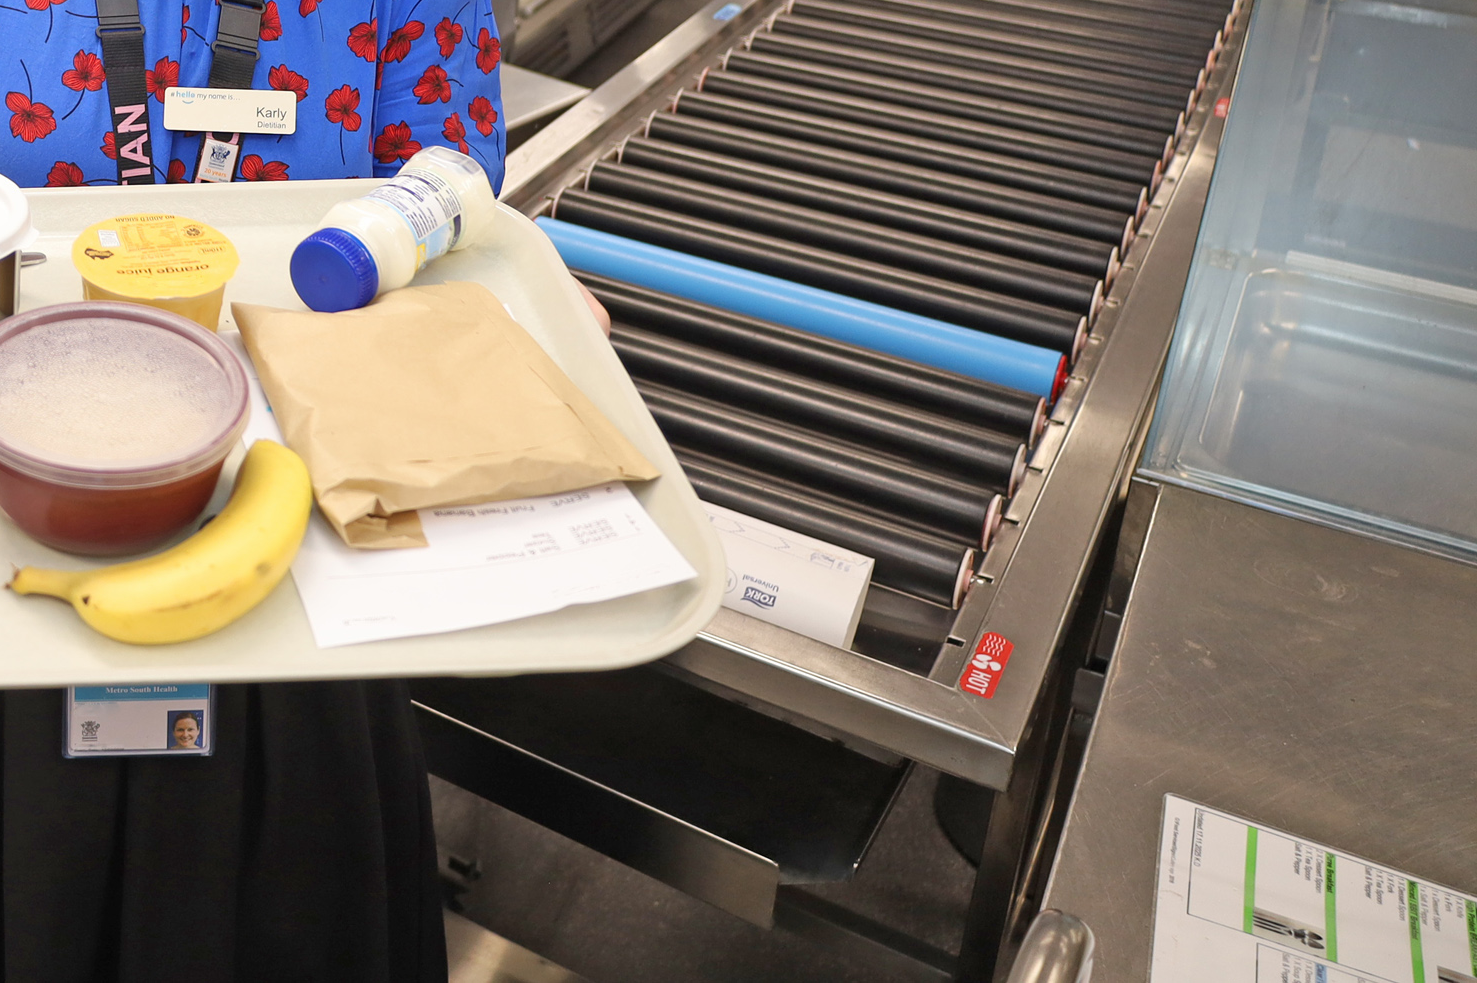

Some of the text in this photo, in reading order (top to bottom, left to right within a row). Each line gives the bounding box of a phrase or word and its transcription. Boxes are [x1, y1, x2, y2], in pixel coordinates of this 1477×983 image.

[256, 107, 287, 121] Karly
[257, 121, 286, 129] Dietitian
[114, 103, 151, 185] IAN
[117, 263, 209, 278] orange juice
[550, 492, 590, 507] SERVE
[433, 509, 476, 517] Banana
[477, 507, 508, 516] Fresh
[510, 505, 535, 514] Fruit
[742, 574, 779, 592] Universal
[746, 587, 776, 607] TORK
[961, 669, 992, 695] HOT
[1315, 877, 1323, 894] Spoon
[1365, 880, 1373, 898] Pepper
[1398, 904, 1406, 921] Spoon
[1410, 916, 1418, 939] Breakfast
[1433, 915, 1441, 931] Spoon
